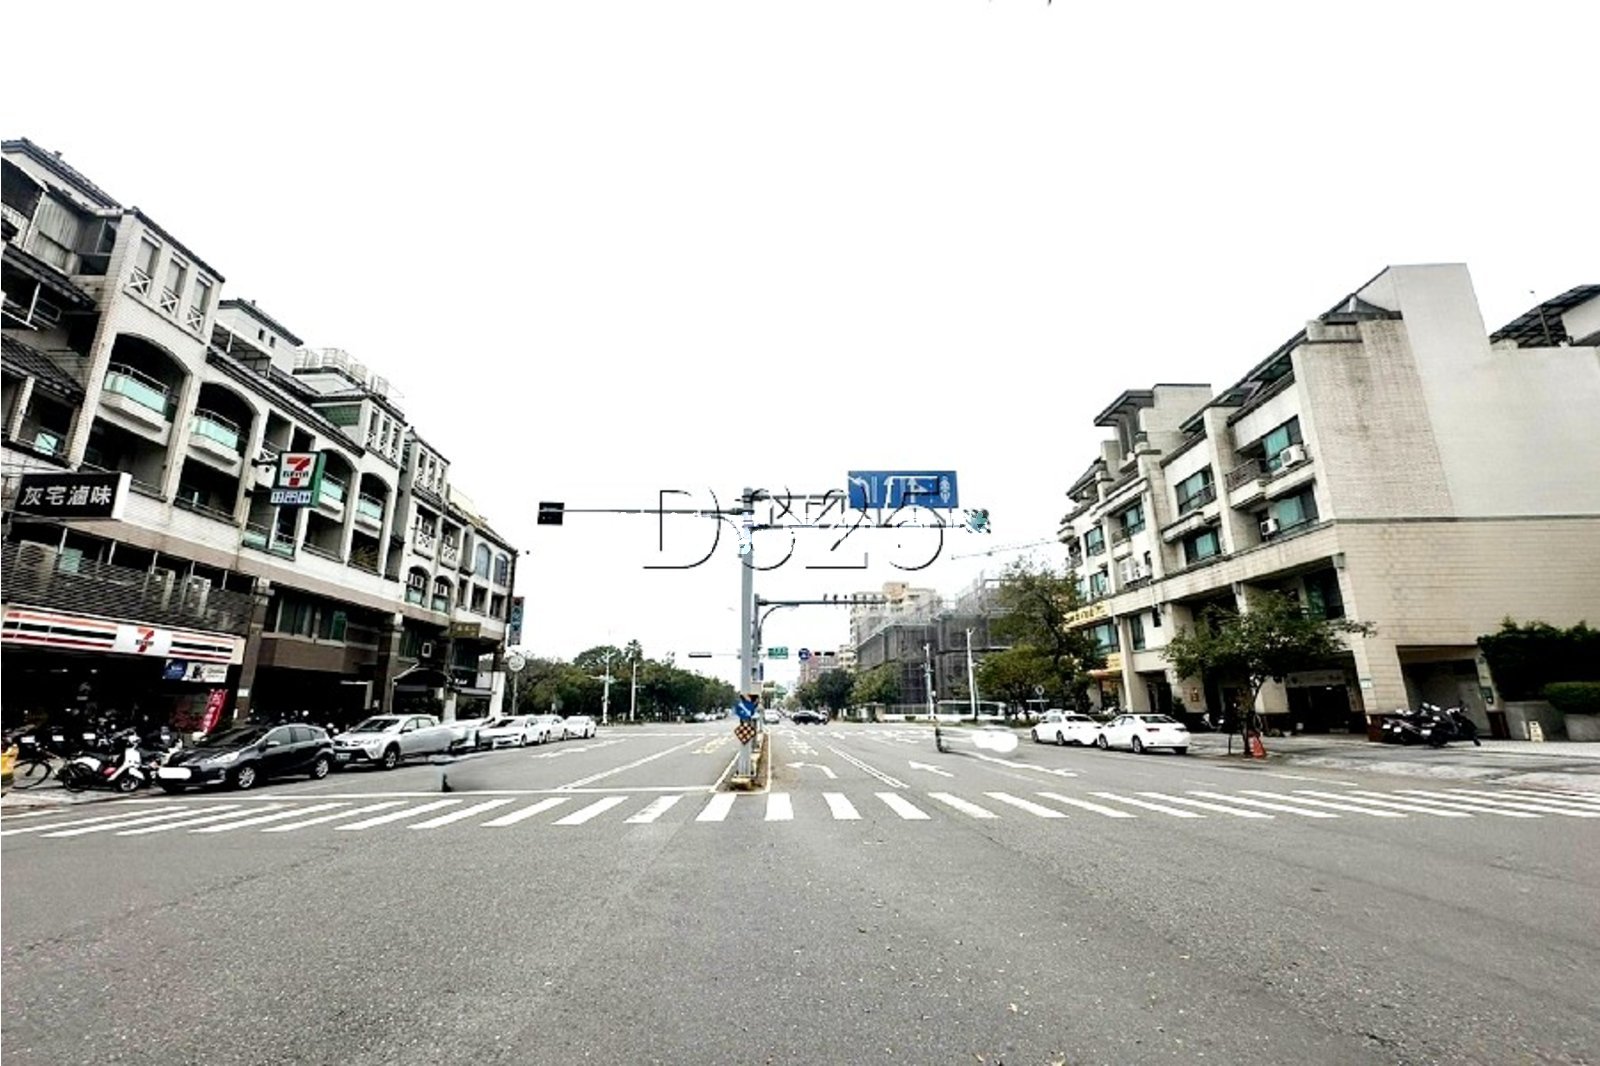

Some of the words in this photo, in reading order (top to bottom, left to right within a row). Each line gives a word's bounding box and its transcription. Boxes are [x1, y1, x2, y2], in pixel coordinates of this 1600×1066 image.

[286, 457, 311, 486] 7
[20, 484, 112, 506] 灰宅滷味
[137, 626, 155, 653] 7
